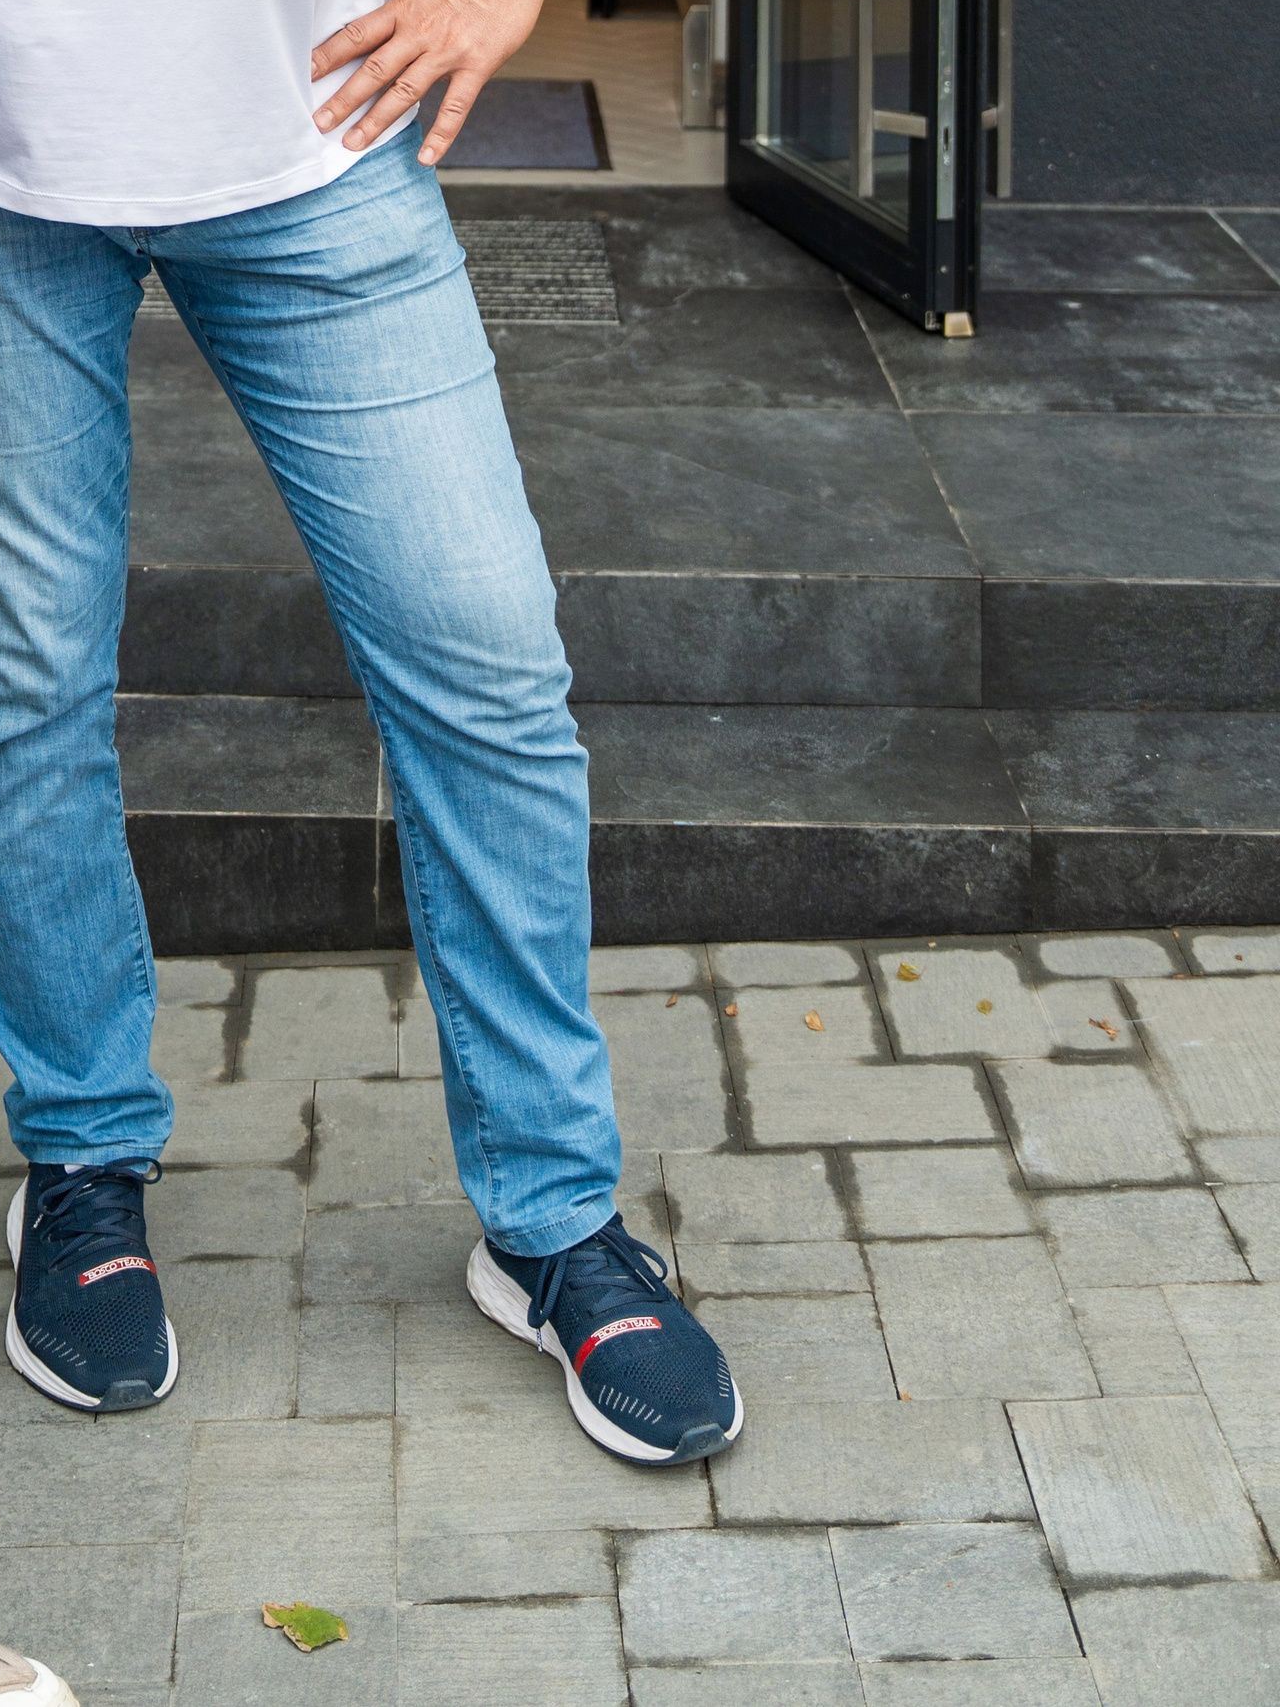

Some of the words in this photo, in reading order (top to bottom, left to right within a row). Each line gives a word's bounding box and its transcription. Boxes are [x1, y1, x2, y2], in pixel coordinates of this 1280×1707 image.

[86, 1262, 118, 1280] BOSCO
[117, 1258, 147, 1269] TEAM
[596, 1321, 628, 1340] BOSCO
[626, 1319, 656, 1328] TEAM
